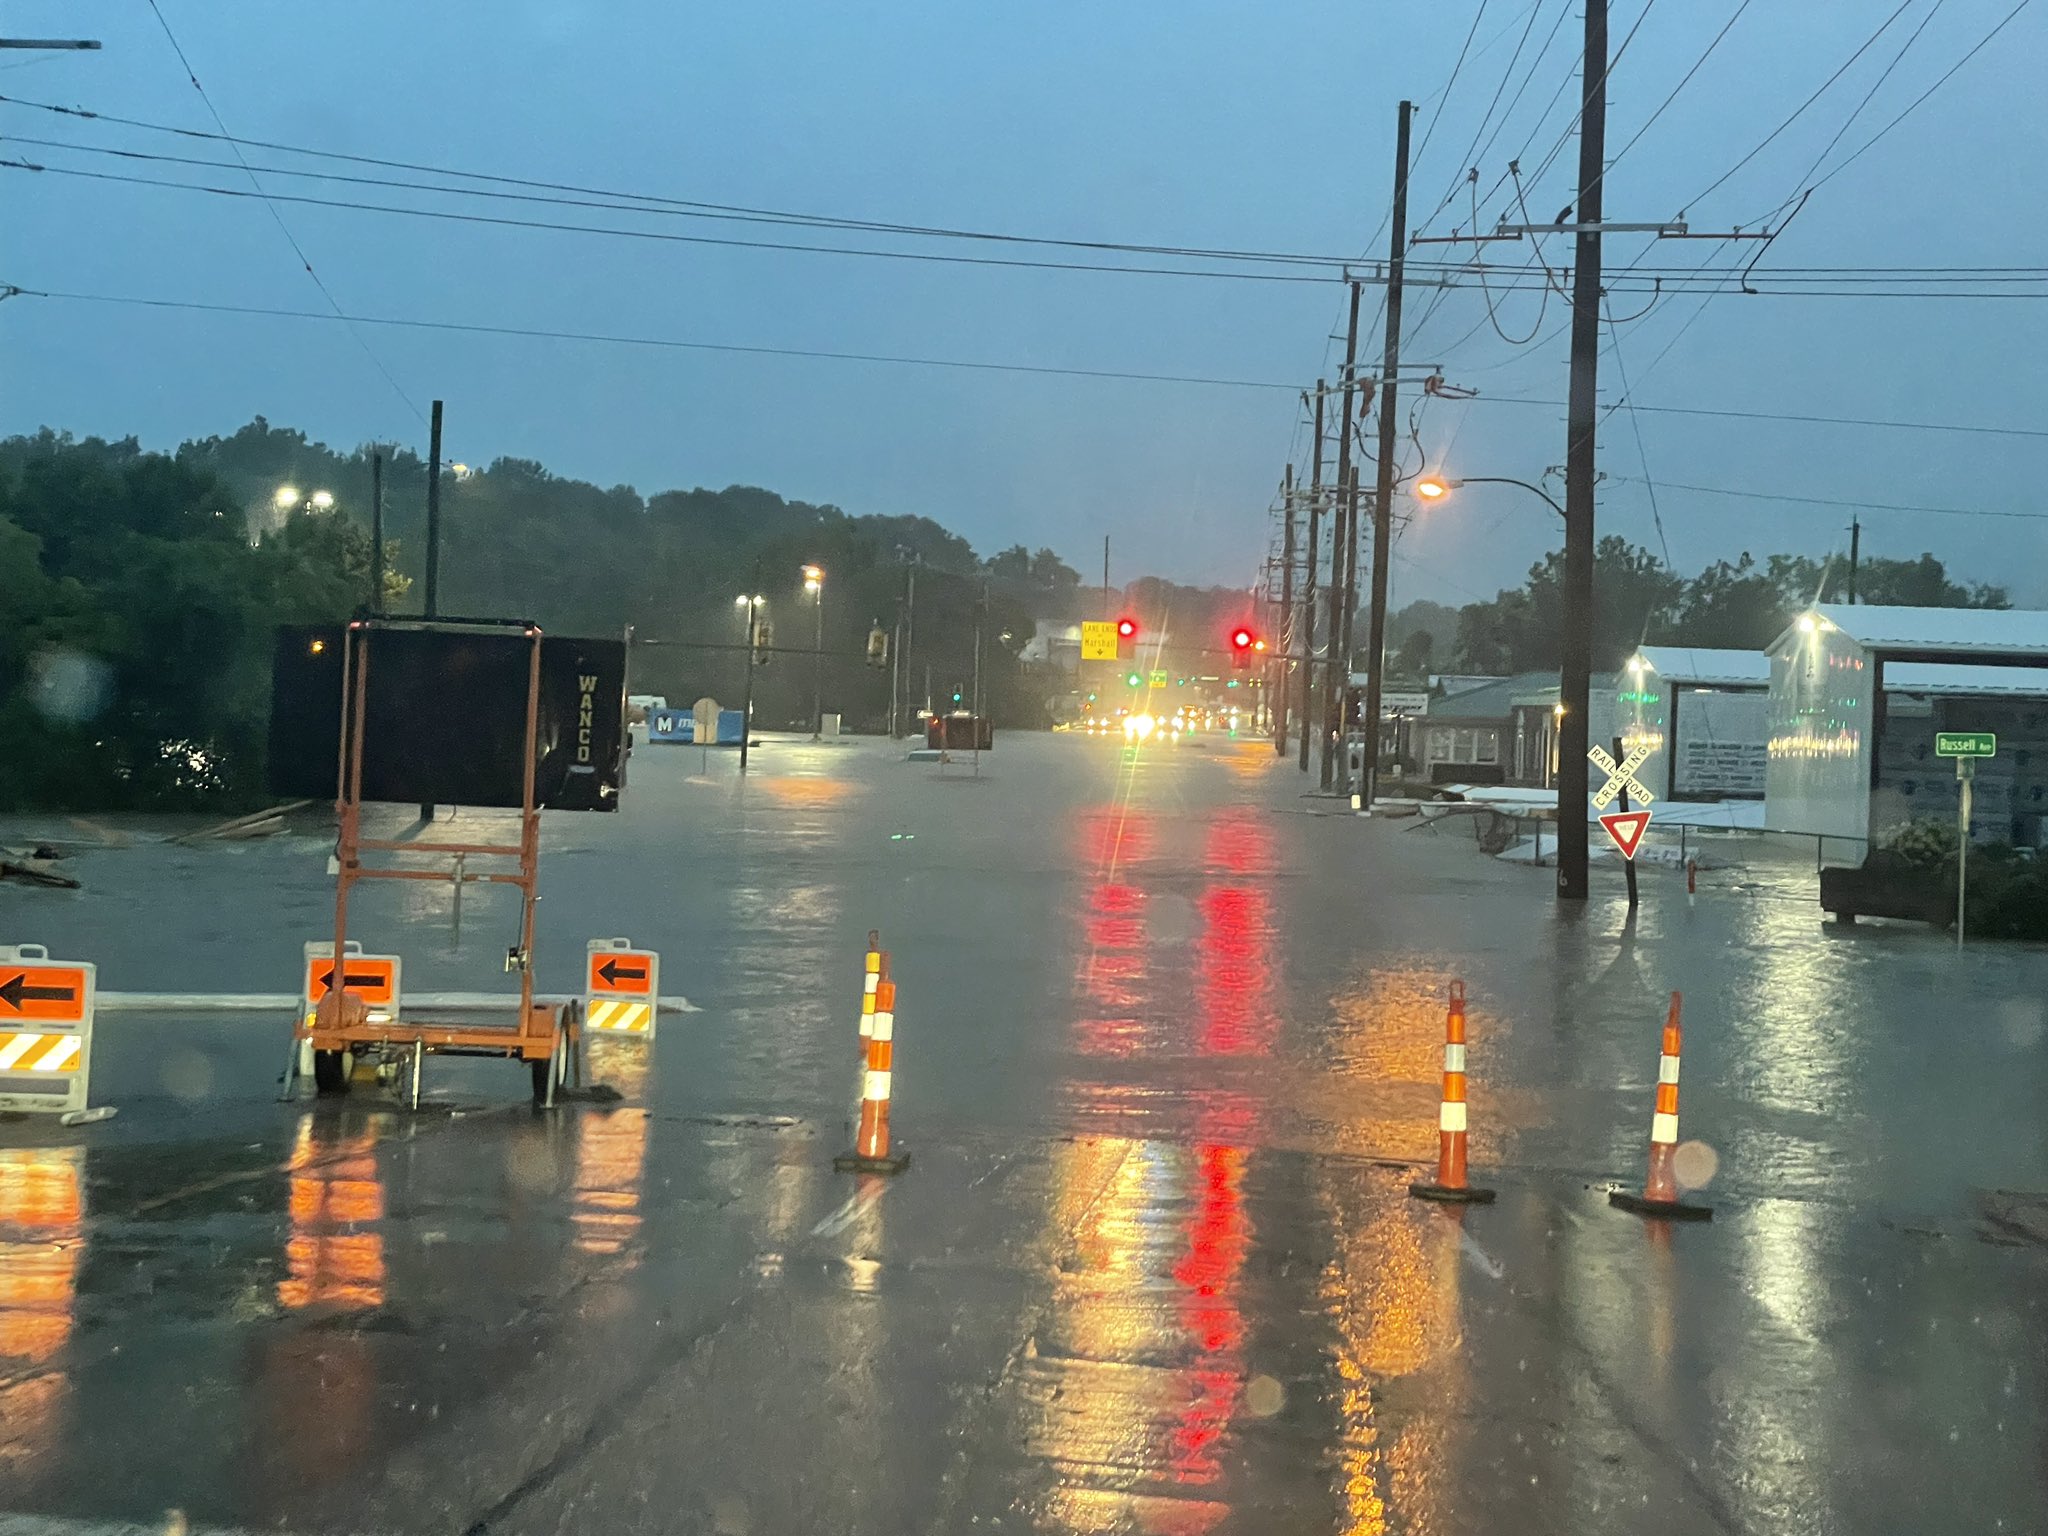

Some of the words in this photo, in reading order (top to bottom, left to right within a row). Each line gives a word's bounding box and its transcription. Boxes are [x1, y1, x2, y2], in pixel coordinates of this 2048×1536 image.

[577, 675, 598, 763] WANCO
[657, 717, 673, 732] M
[1940, 738, 1976, 751] Russell
[1591, 748, 1616, 774] RAIL
[1625, 777, 1650, 803] ROAD
[1596, 746, 1647, 806] CROSSING
